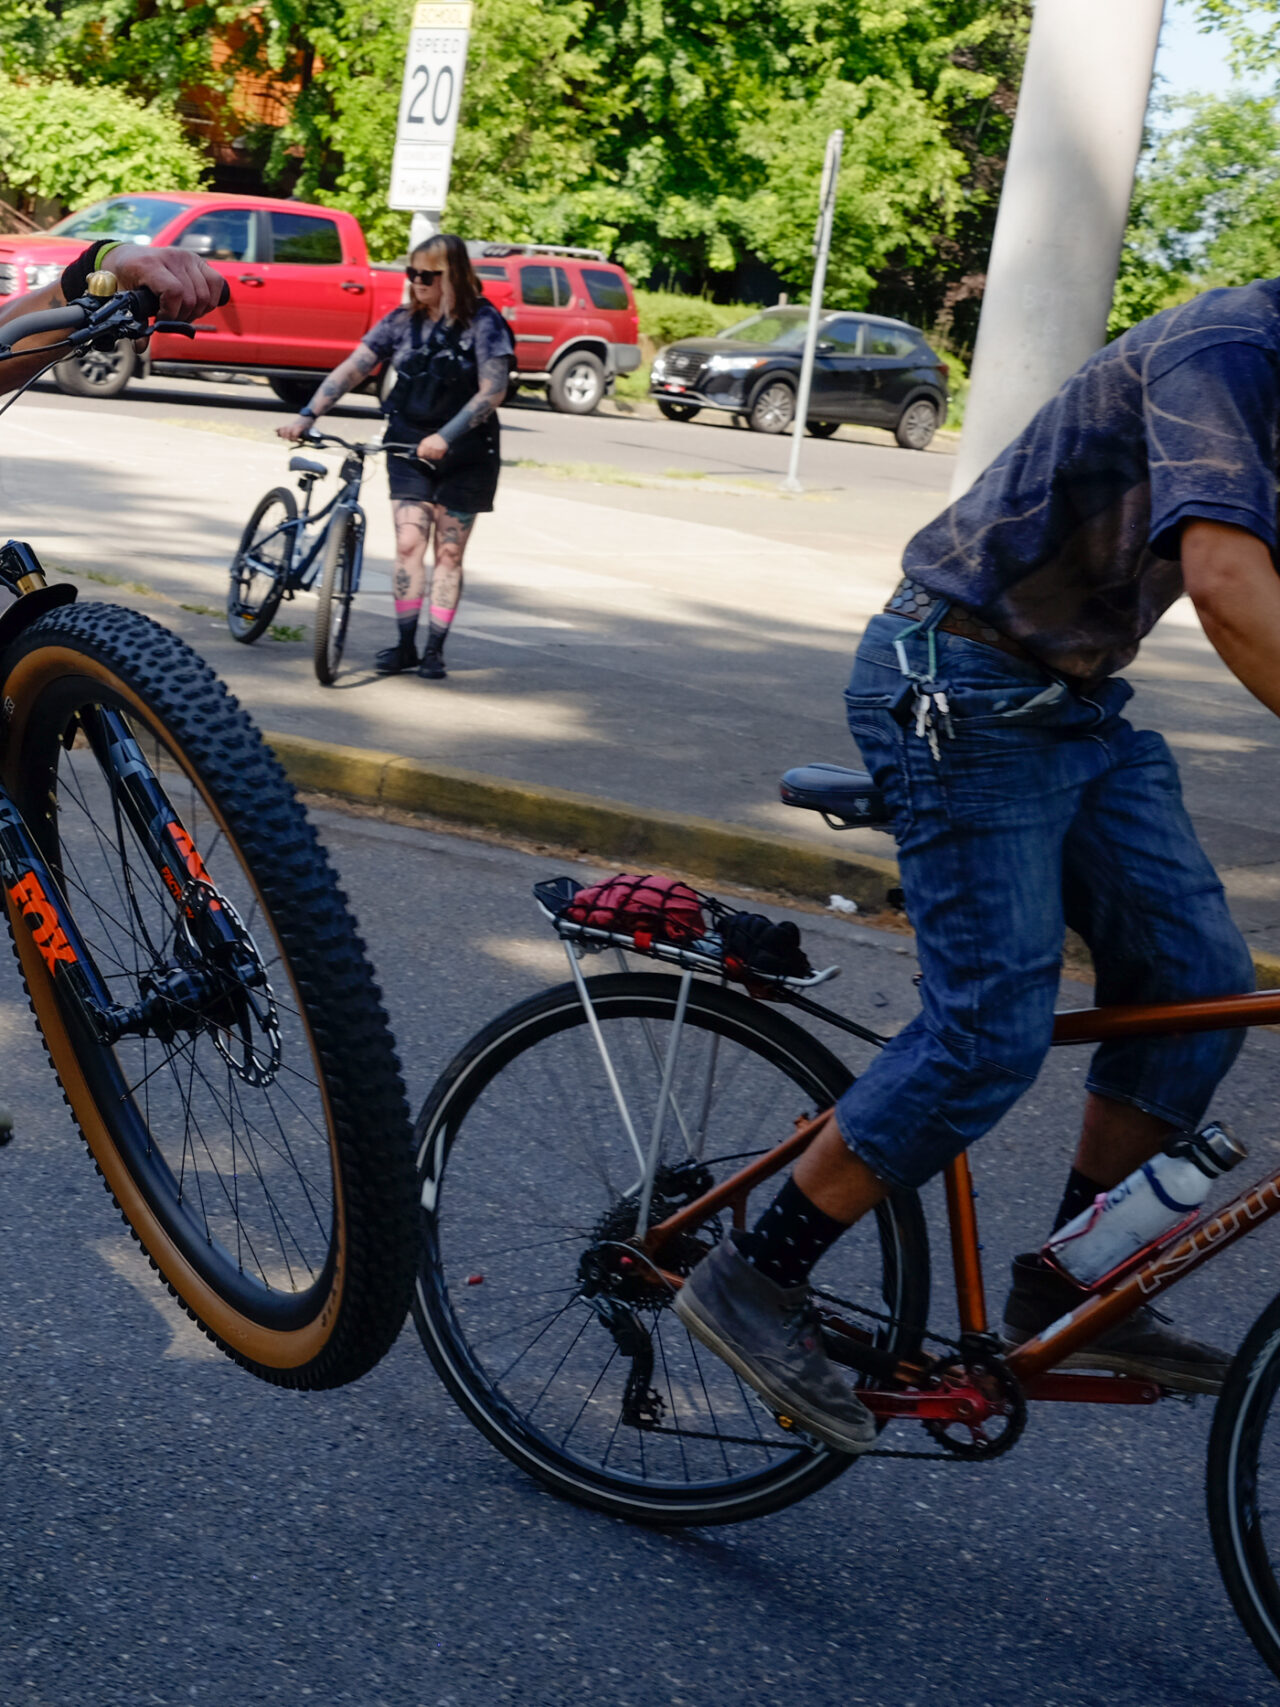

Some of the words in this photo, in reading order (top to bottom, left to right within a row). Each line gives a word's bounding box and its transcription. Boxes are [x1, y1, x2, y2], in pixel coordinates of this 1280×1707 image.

[419, 7, 463, 24] SCHOOL
[415, 37, 460, 54] SPEED
[406, 64, 455, 127] 20
[9, 870, 78, 978] FOX
